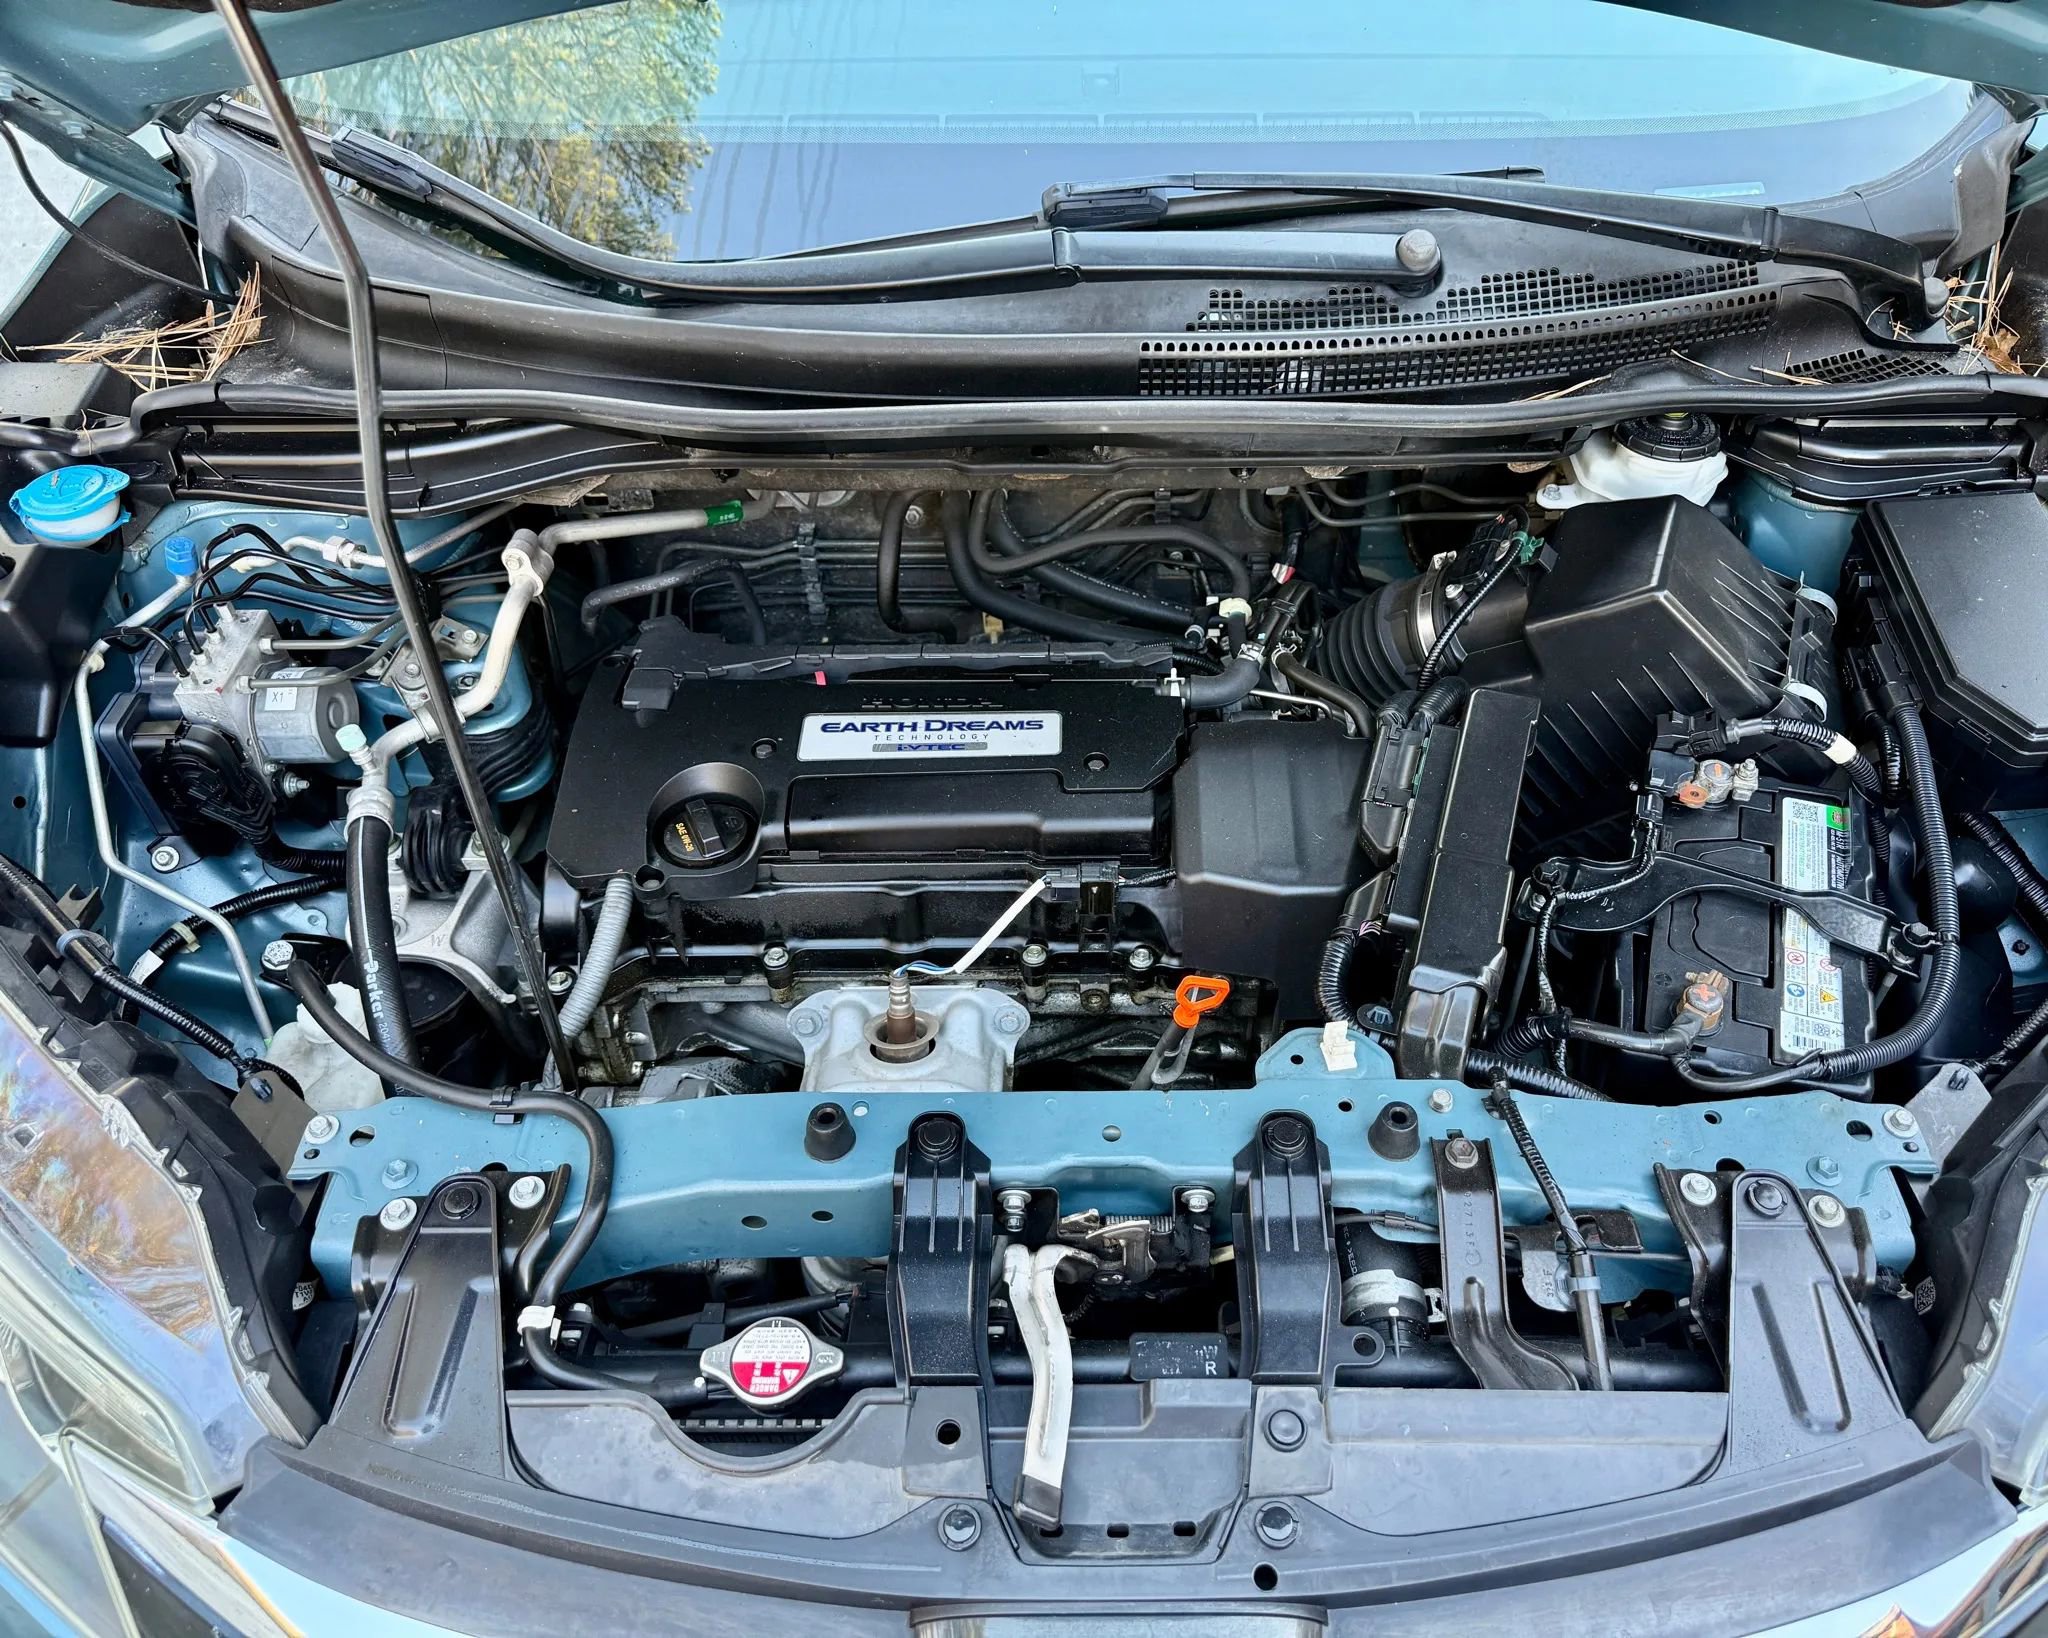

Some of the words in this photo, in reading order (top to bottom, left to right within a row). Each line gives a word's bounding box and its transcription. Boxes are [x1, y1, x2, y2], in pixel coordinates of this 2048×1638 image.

[820, 721, 918, 733] EARTH
[924, 719, 1044, 732] DREAMS
[874, 733, 989, 741] TECHNOLOGY
[675, 822, 688, 836] SAE
[363, 960, 385, 1019] Parker
[1205, 1361, 1217, 1375] R
[749, 1383, 781, 1393] DANGER
